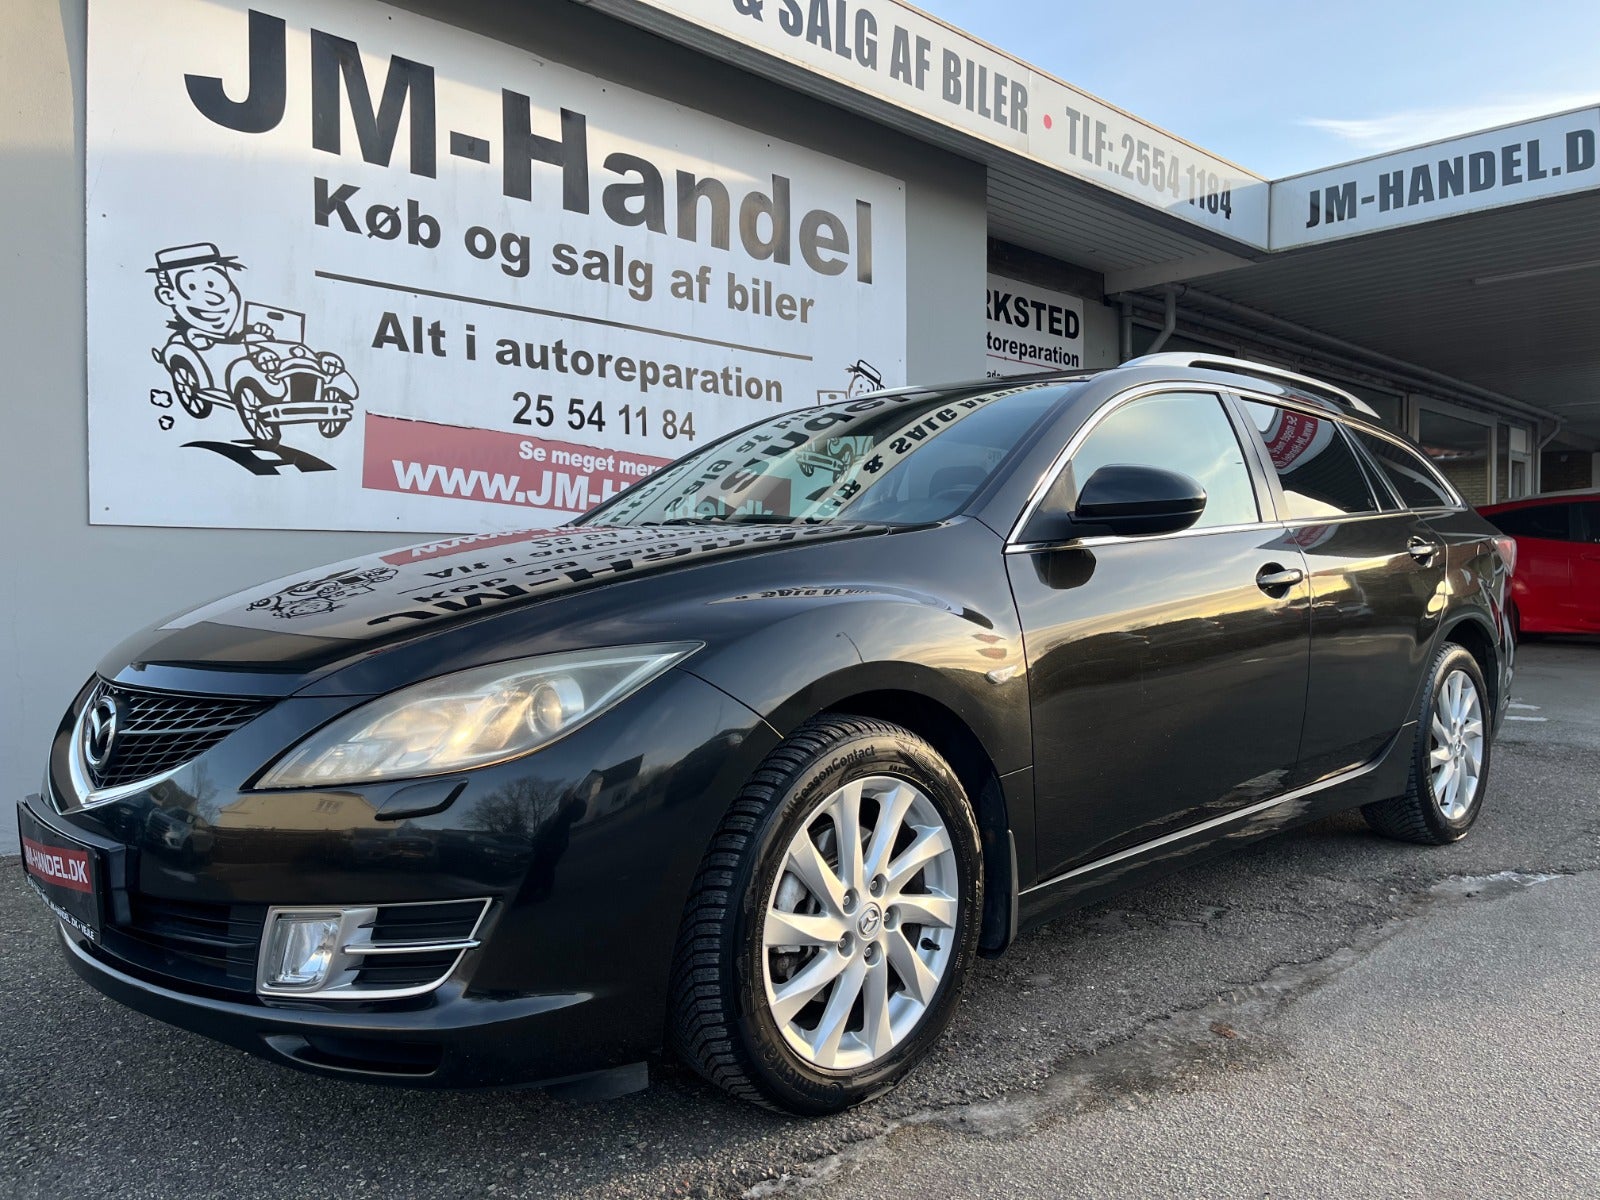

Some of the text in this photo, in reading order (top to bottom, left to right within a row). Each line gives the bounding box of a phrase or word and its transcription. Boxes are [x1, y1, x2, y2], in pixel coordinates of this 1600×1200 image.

[779, 0, 1028, 135] SALG AF BILER
[184, 9, 872, 284] JM-Handel
[1186, 164, 1231, 220] 1184
[1306, 129, 1595, 228] JM-HANDEL.D
[314, 177, 814, 324] Køb og salg af biler
[371, 311, 783, 402] Alt i autoreparation
[512, 392, 695, 441] 25 54 11 84
[519, 441, 546, 461] Se
[552, 449, 614, 474] meget
